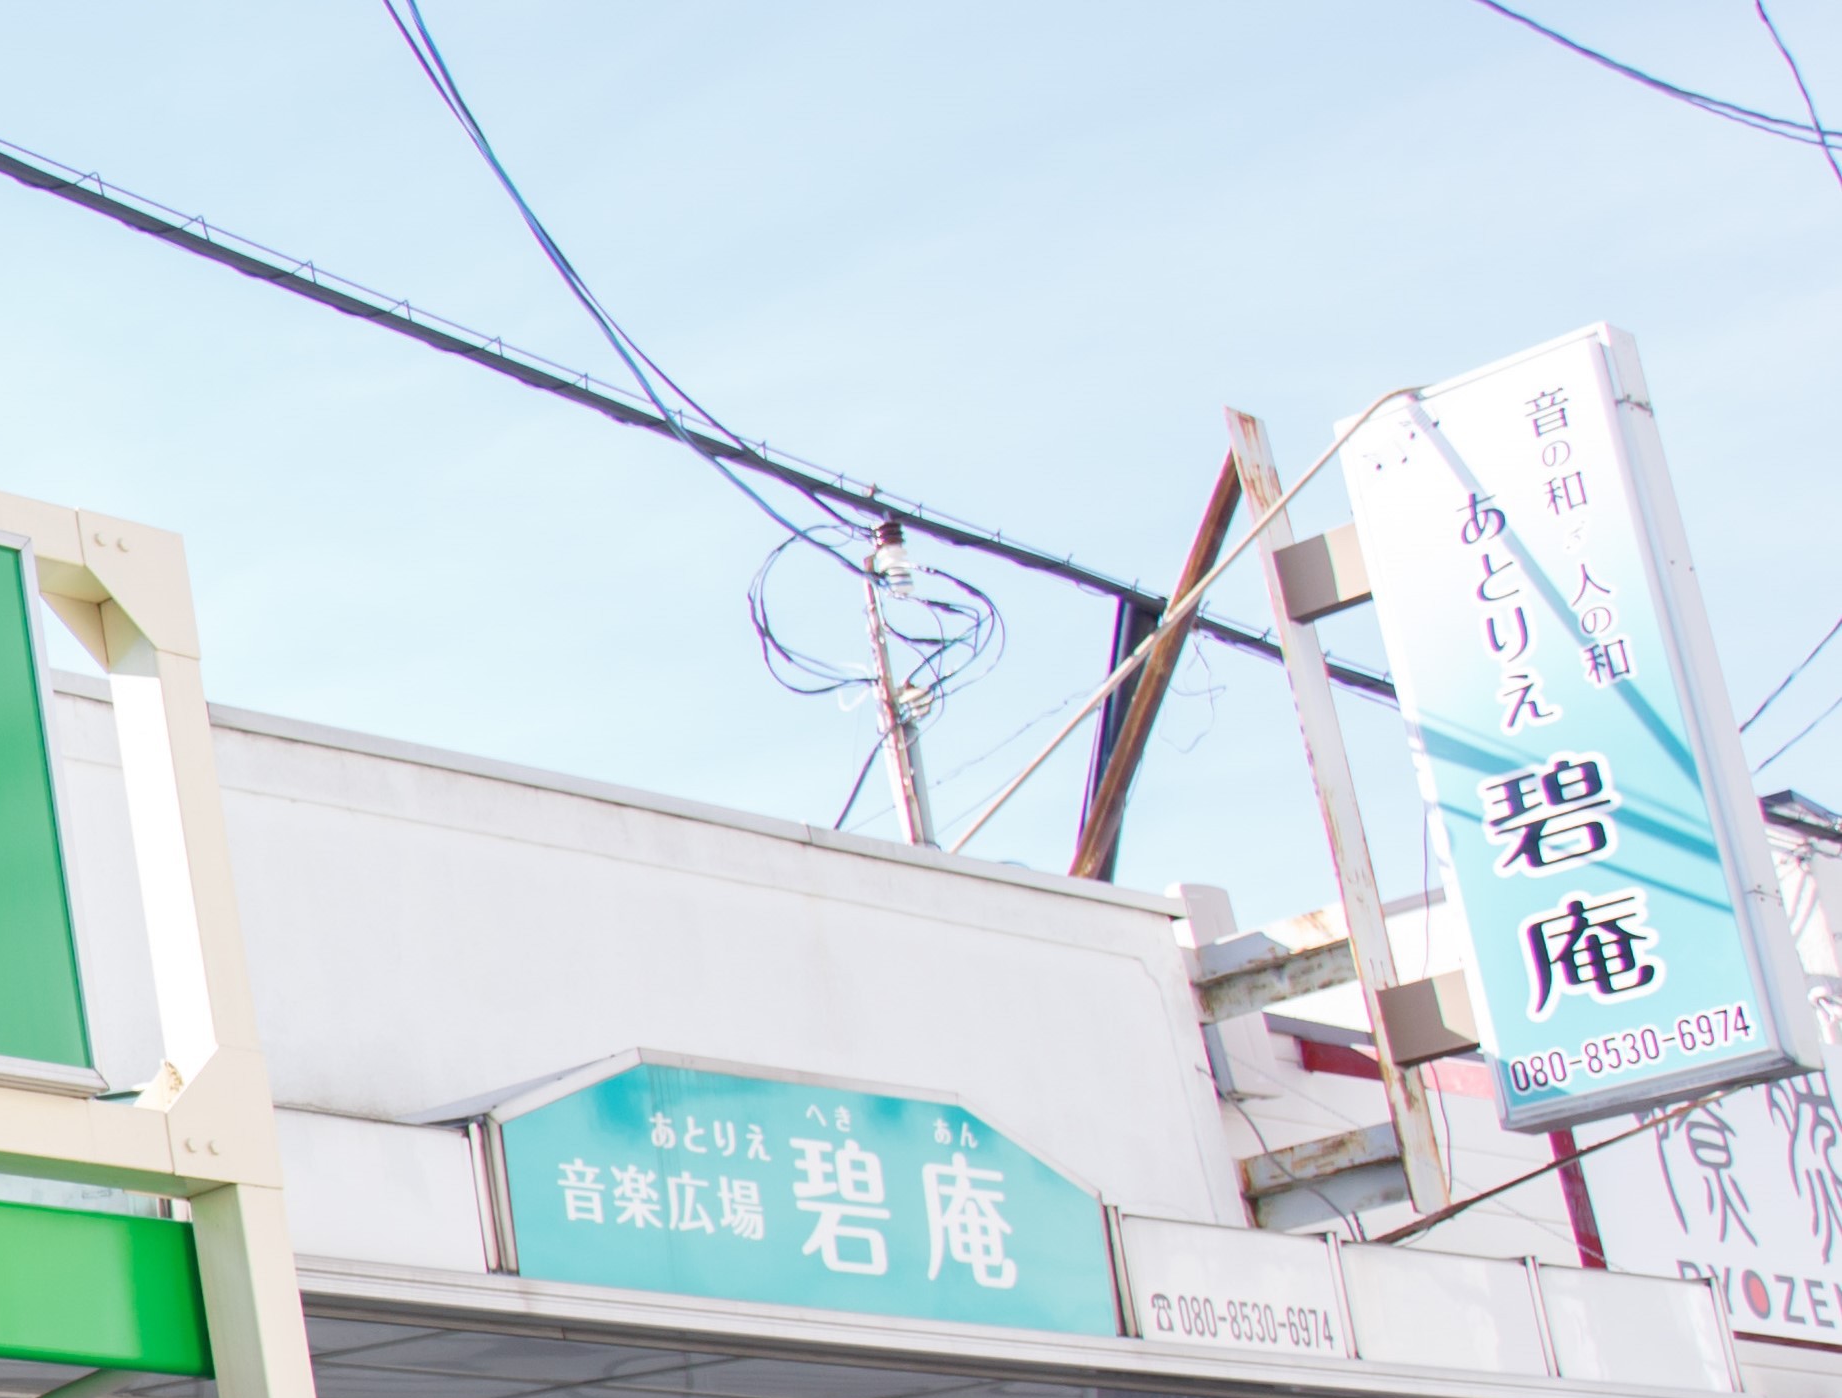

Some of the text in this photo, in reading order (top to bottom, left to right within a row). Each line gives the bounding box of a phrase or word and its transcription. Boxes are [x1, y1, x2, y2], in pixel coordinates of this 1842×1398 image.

[1524, 387, 1630, 684] 音の和 人の和
[1456, 492, 1655, 1013] あとりえ 碧庵
[1511, 1006, 1750, 1093] 080-8530-6974
[650, 1111, 771, 1162] あとりえ
[806, 1105, 978, 1149] へき あん
[557, 1138, 1017, 1289] 音楽広場 碧庵
[1177, 1295, 1333, 1350] 080-8530-6974
[1676, 1259, 1842, 1329] YOZE
